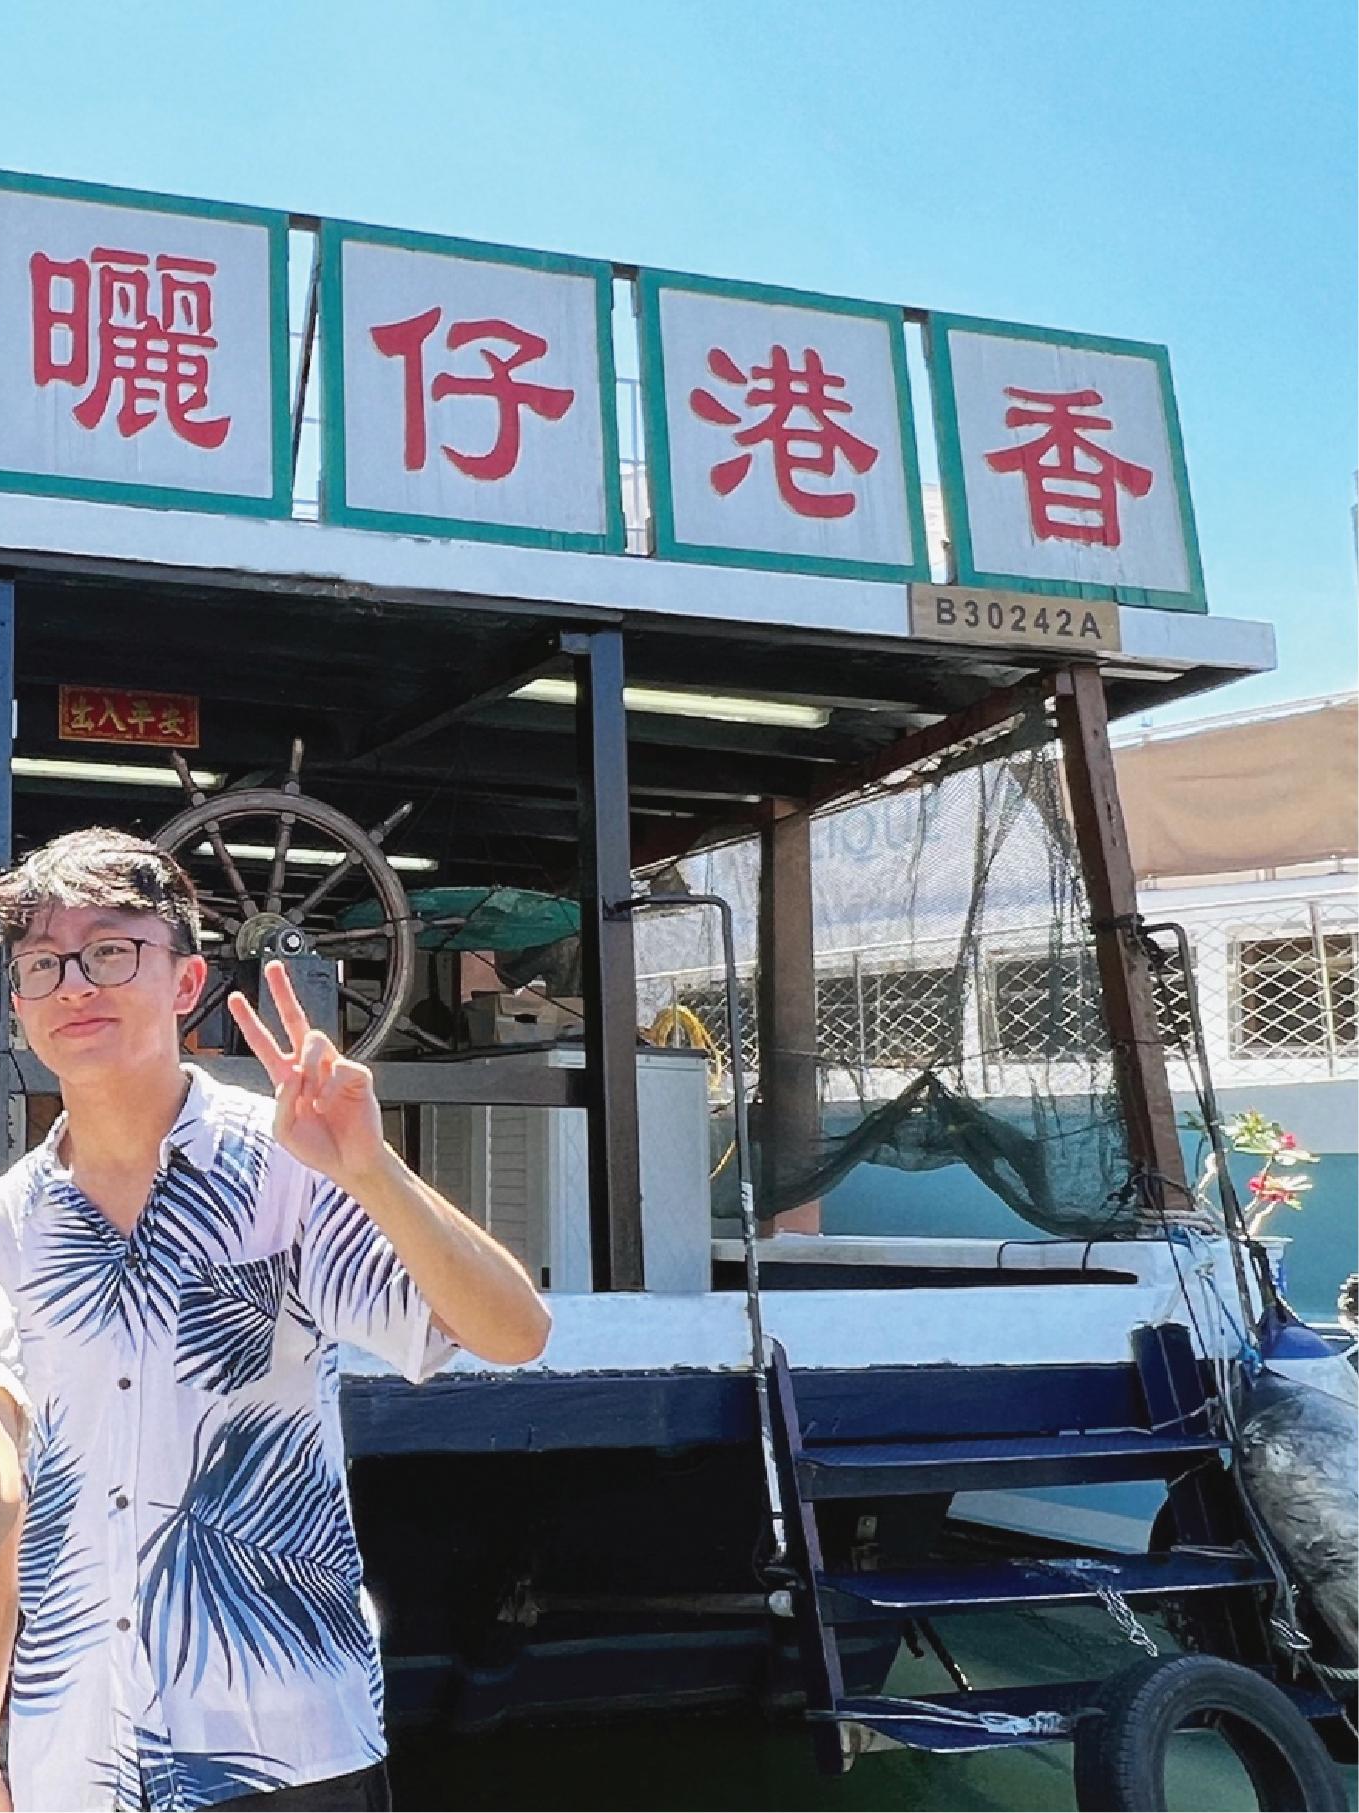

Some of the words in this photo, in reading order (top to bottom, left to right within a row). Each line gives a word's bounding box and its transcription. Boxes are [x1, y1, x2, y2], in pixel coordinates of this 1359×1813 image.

[936, 597, 1102, 640] B30242A
[69, 695, 186, 737] 出入平安
